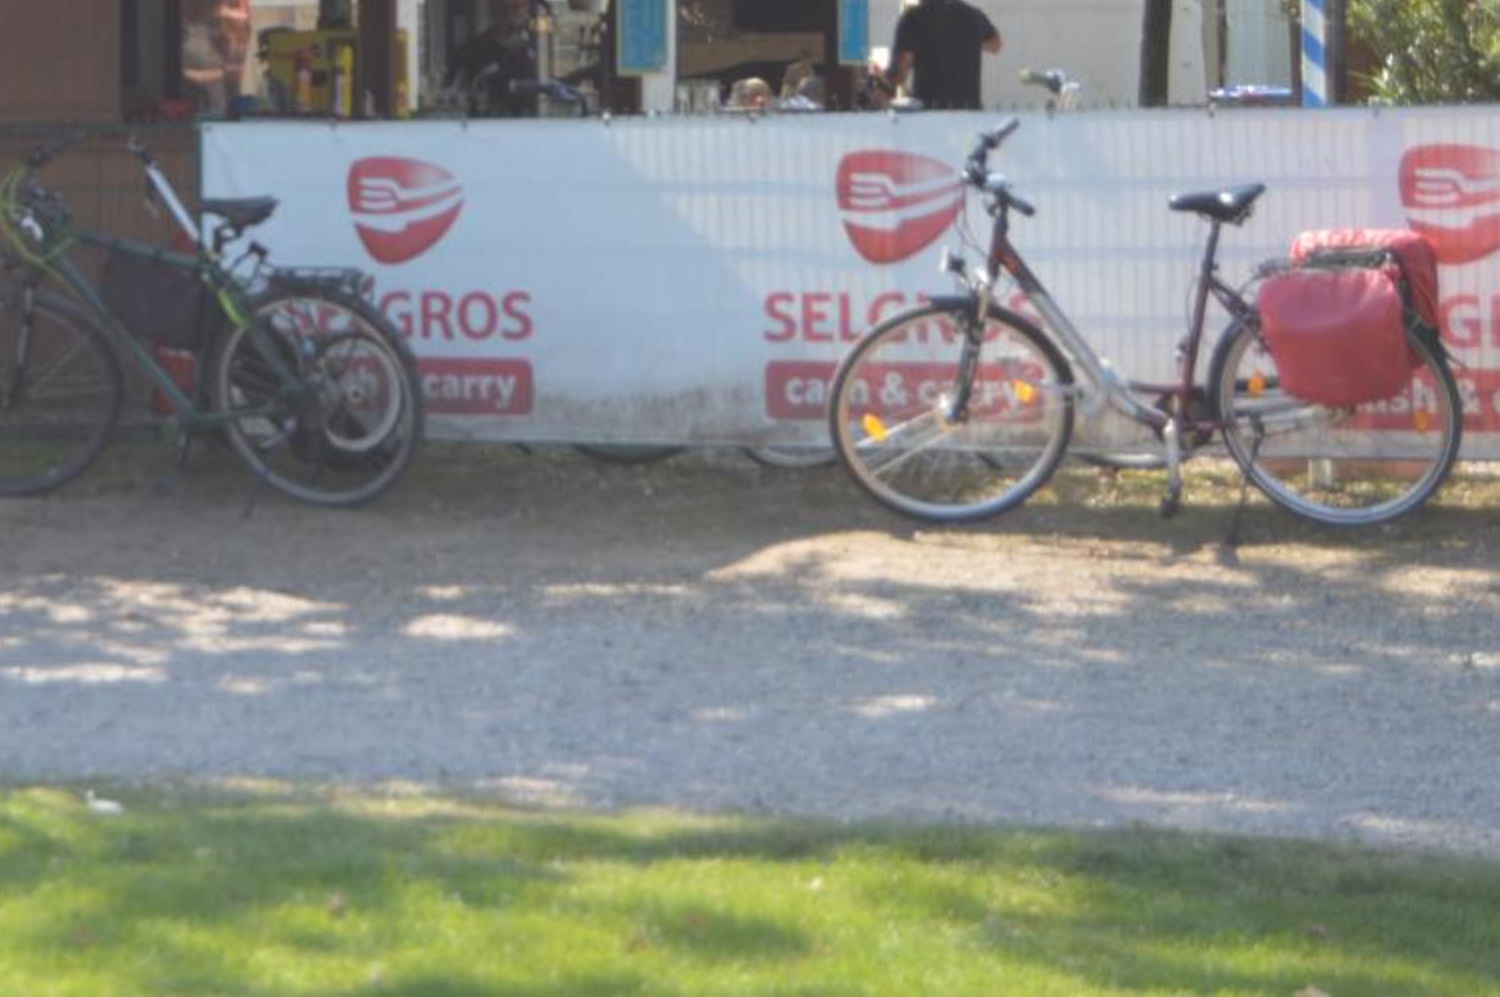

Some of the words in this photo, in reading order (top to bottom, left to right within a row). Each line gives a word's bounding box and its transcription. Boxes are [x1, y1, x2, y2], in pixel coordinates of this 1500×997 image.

[280, 290, 535, 341] GROS
[763, 292, 1043, 343] SELG
[785, 373, 869, 406] cah
